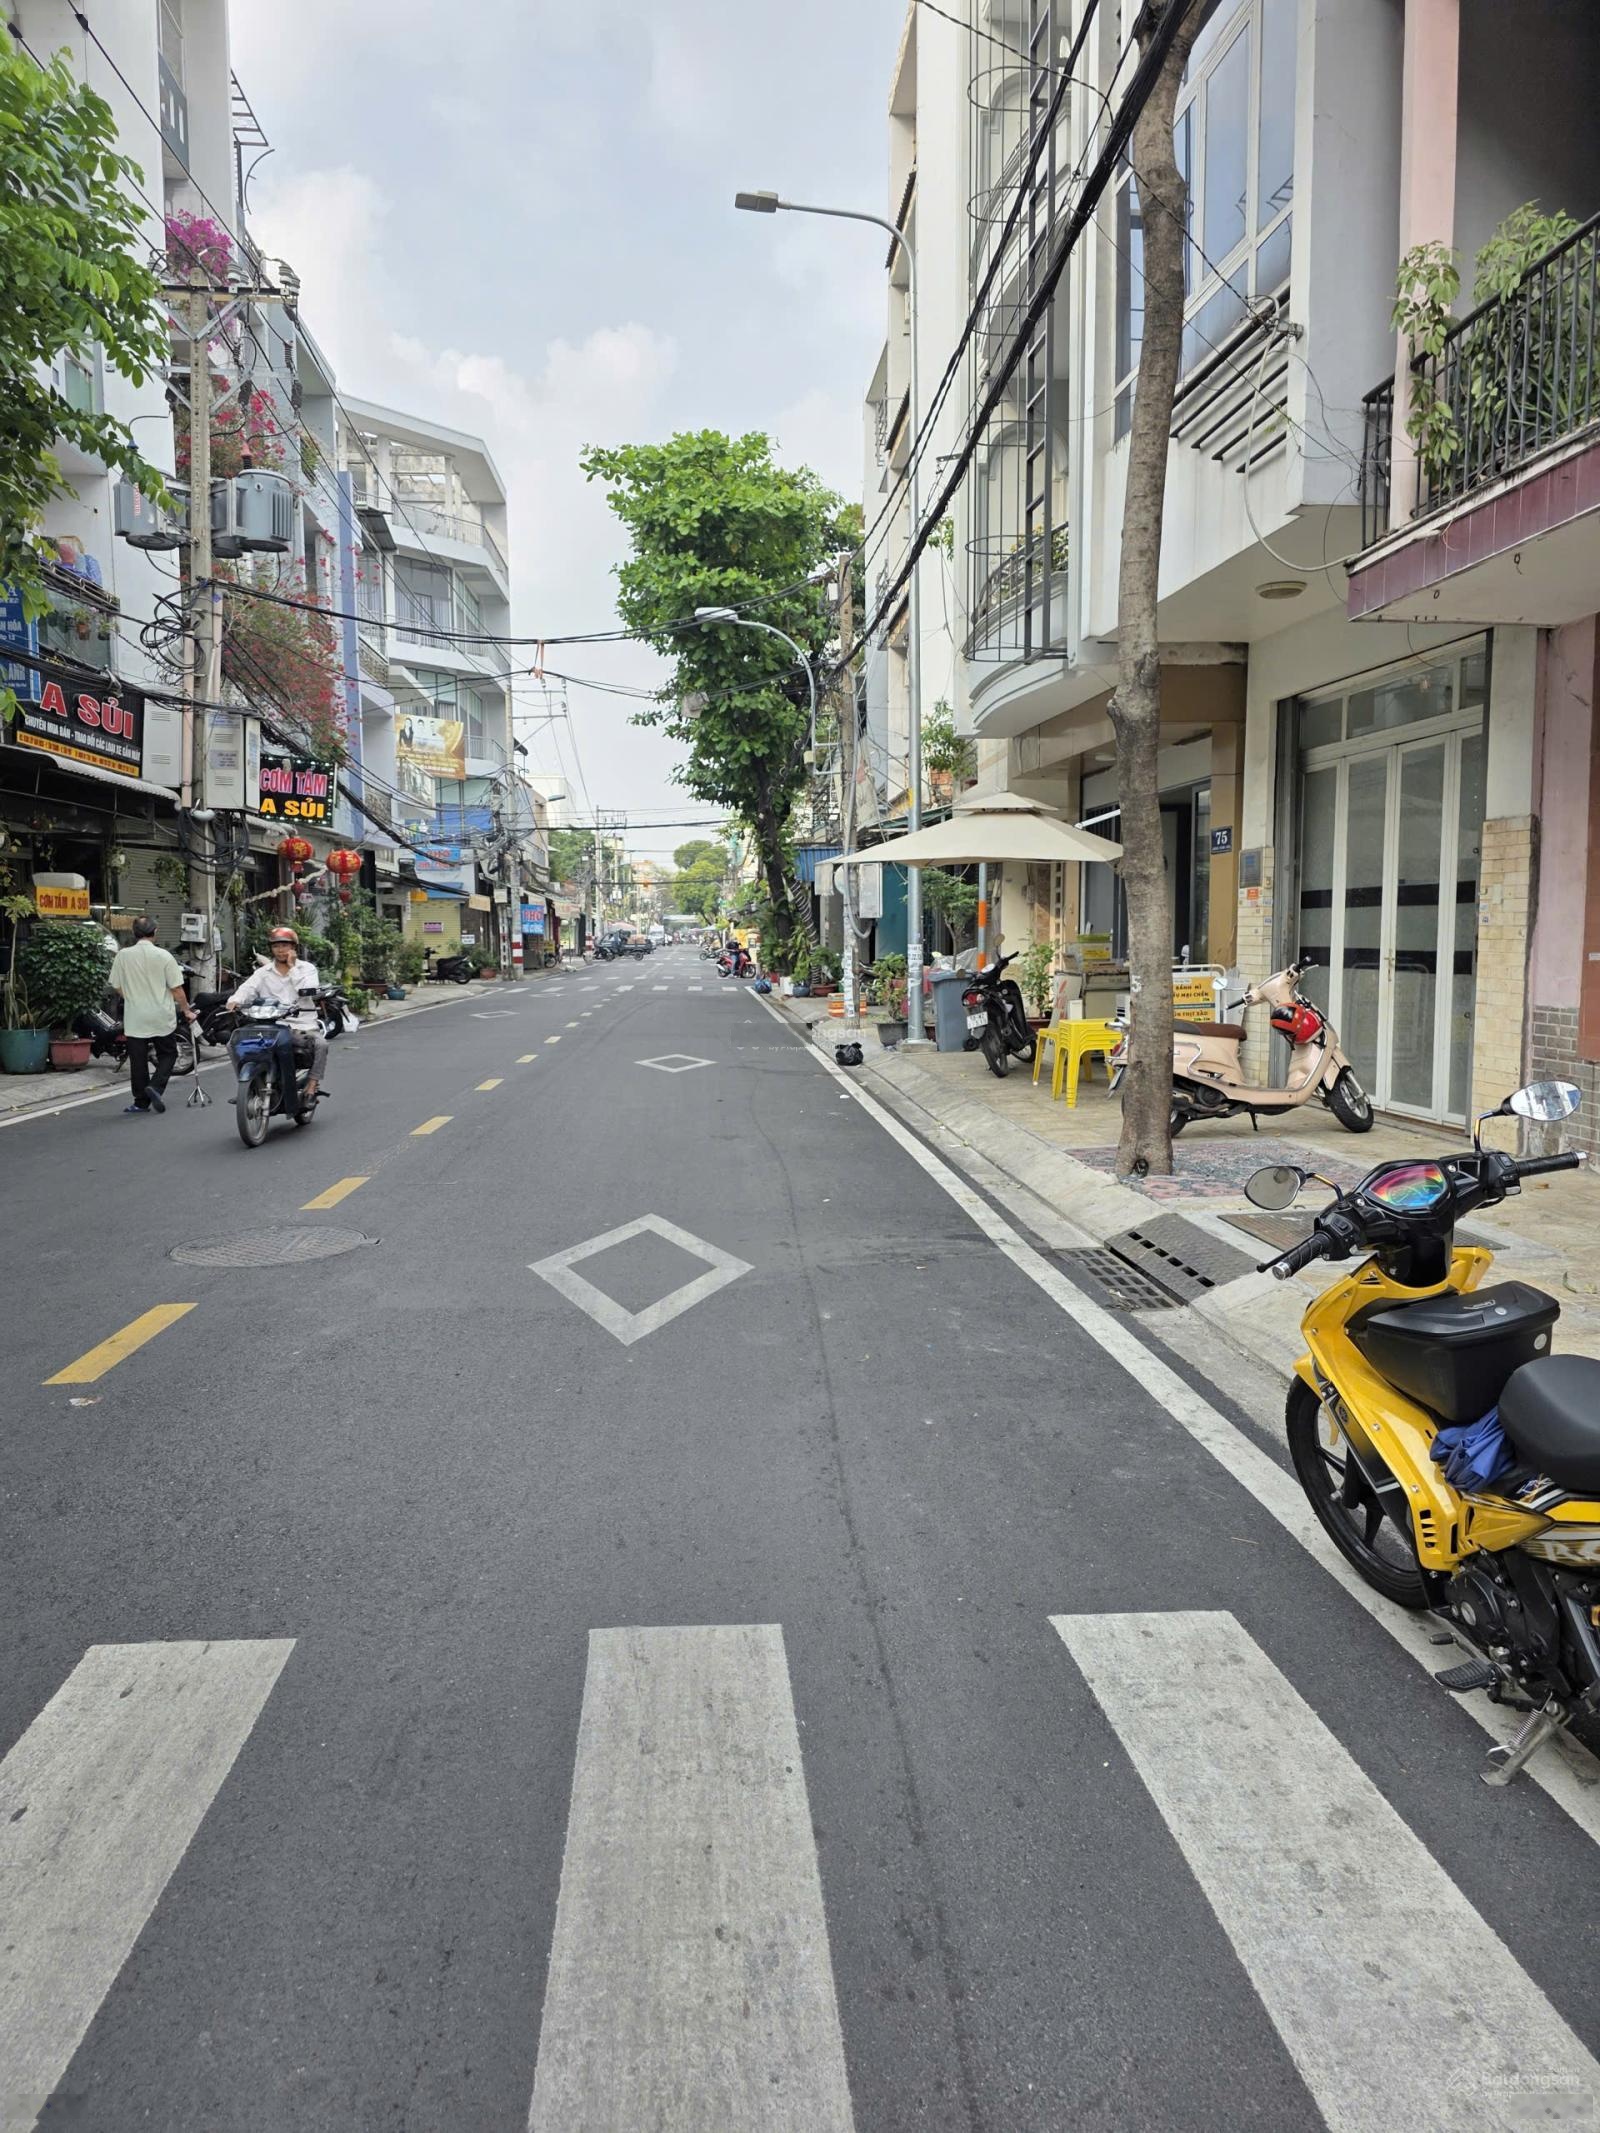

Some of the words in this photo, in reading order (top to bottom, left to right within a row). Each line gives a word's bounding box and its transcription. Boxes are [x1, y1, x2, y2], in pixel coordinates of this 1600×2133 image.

[40, 681, 68, 717] A
[77, 694, 134, 739] SỦI
[260, 768, 293, 794] CƠM
[260, 798, 276, 814] A
[284, 798, 324, 818] SỦI
[1215, 830, 1228, 845] 75
[71, 897, 76, 909] A
